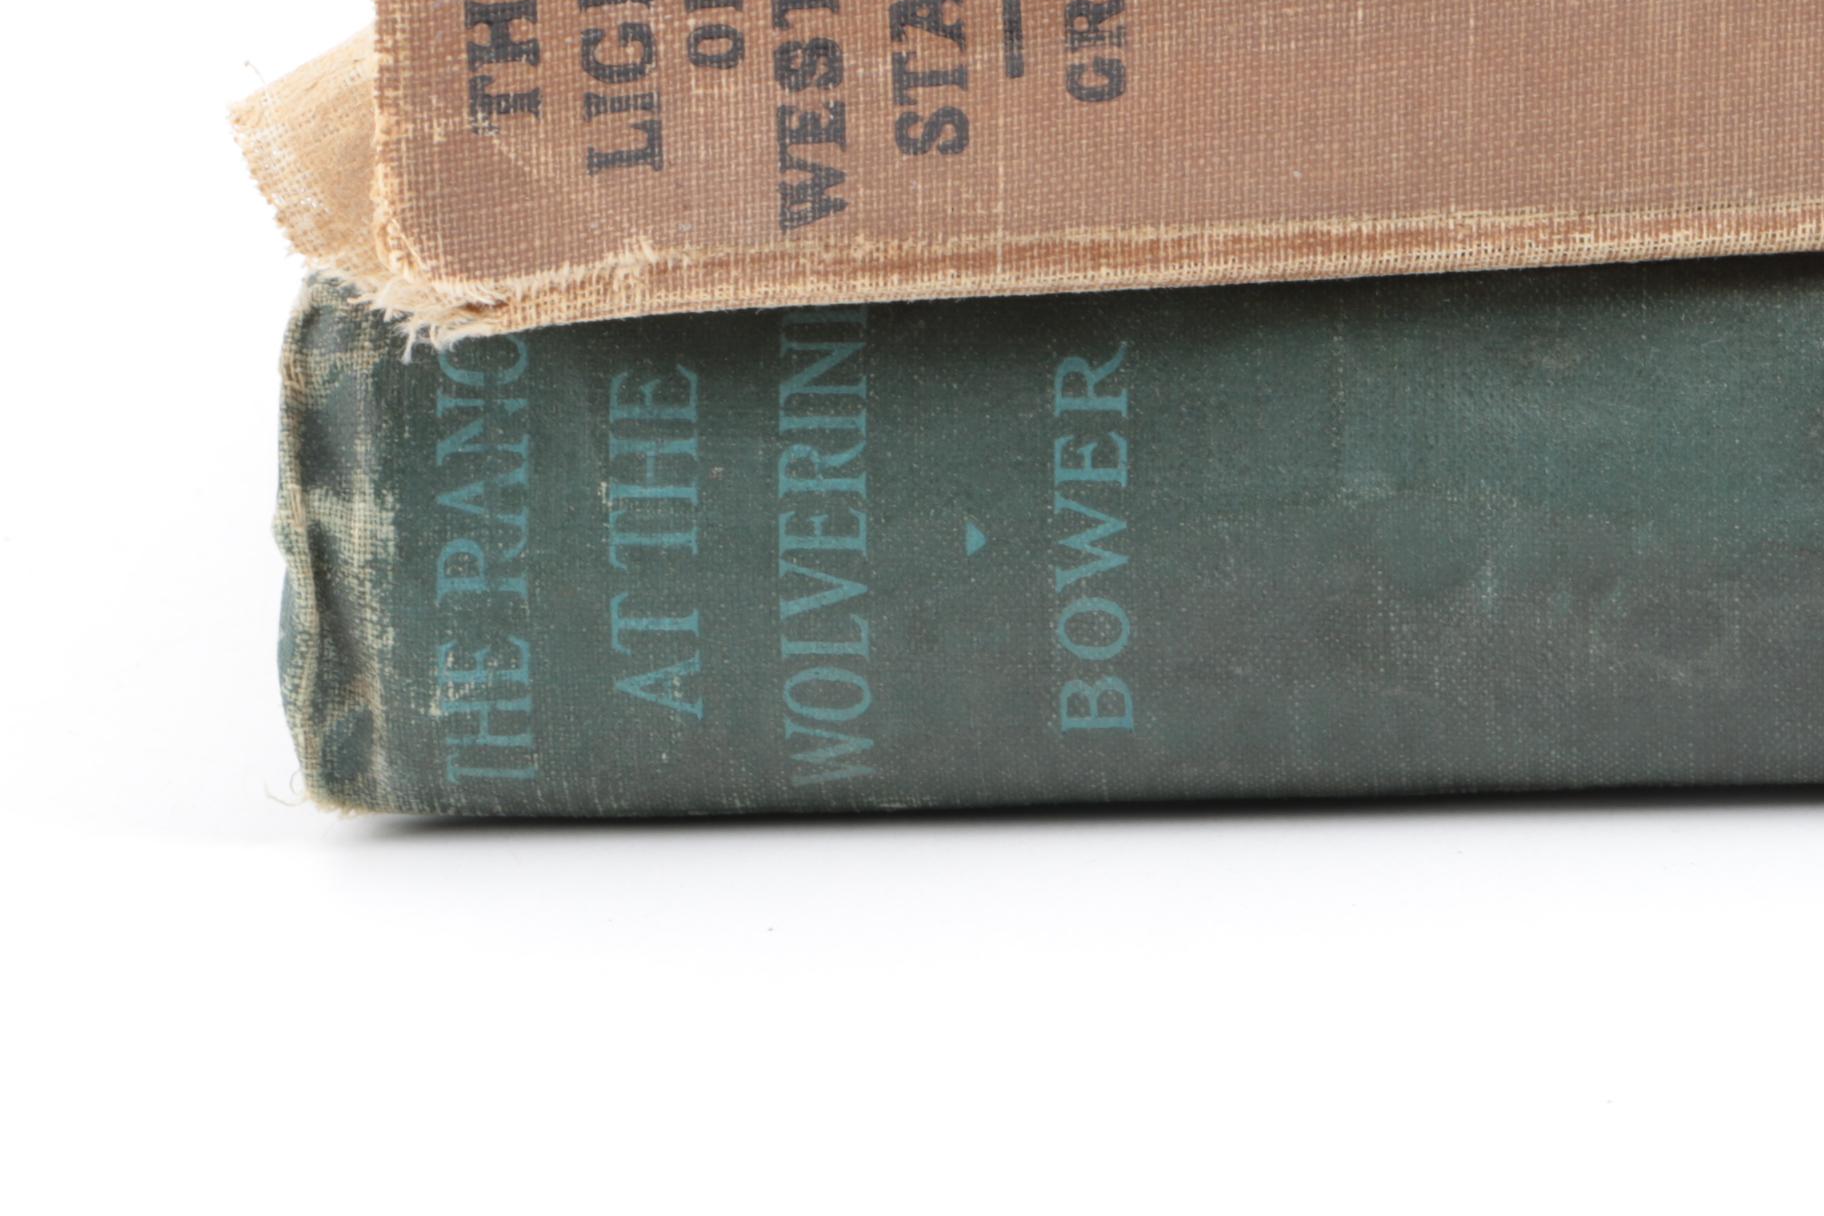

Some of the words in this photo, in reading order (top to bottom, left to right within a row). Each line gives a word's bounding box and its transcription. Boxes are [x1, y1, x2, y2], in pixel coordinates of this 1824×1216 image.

[607, 363, 700, 570] THE
[1053, 342, 1137, 734] BOWER
[436, 637, 541, 783] THE
[610, 592, 707, 719] AT
